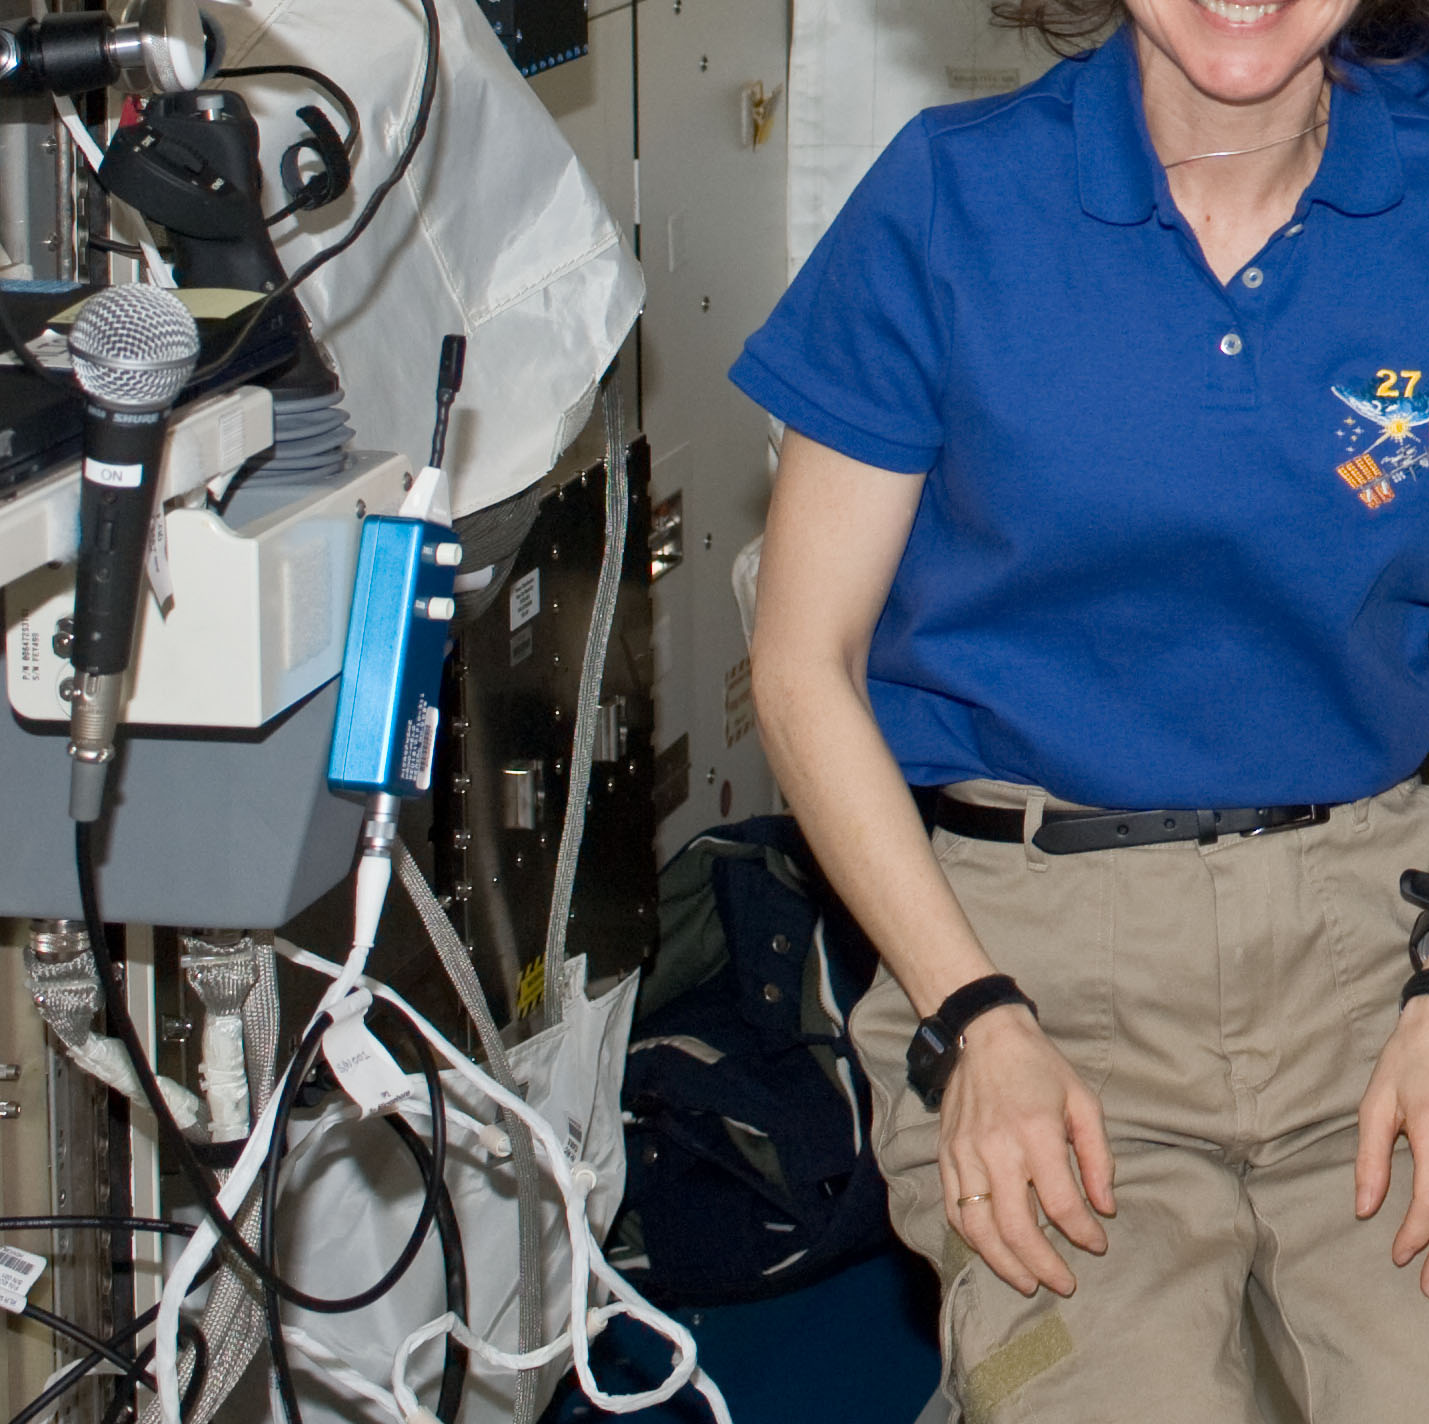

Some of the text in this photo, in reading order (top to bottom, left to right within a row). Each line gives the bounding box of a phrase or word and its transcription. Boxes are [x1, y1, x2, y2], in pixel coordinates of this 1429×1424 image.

[1375, 369, 1422, 398] 27
[112, 412, 160, 424] SHURE
[100, 468, 123, 482] ON
